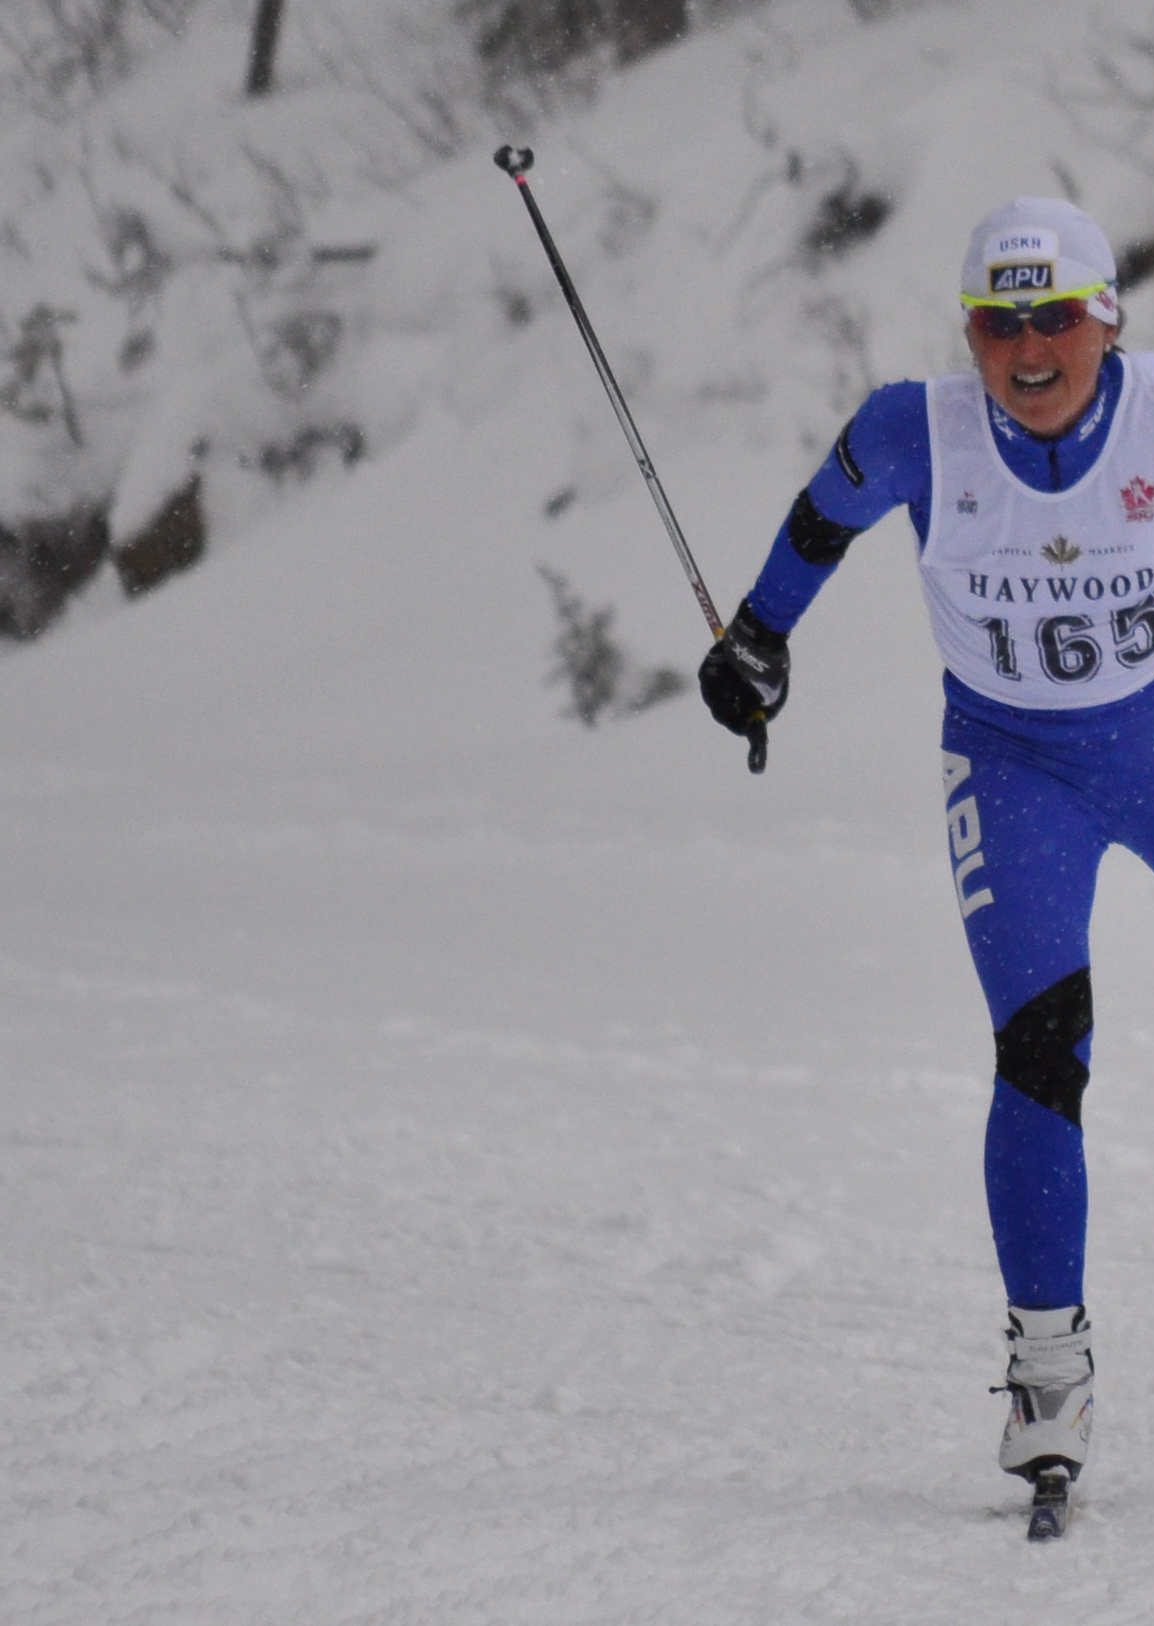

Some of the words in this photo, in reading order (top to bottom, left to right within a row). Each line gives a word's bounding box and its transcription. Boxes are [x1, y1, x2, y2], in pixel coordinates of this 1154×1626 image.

[1000, 237, 1042, 252] USKH
[994, 267, 1048, 290] APU
[968, 567, 1154, 603] HAYWOOD
[942, 750, 995, 920] APU
